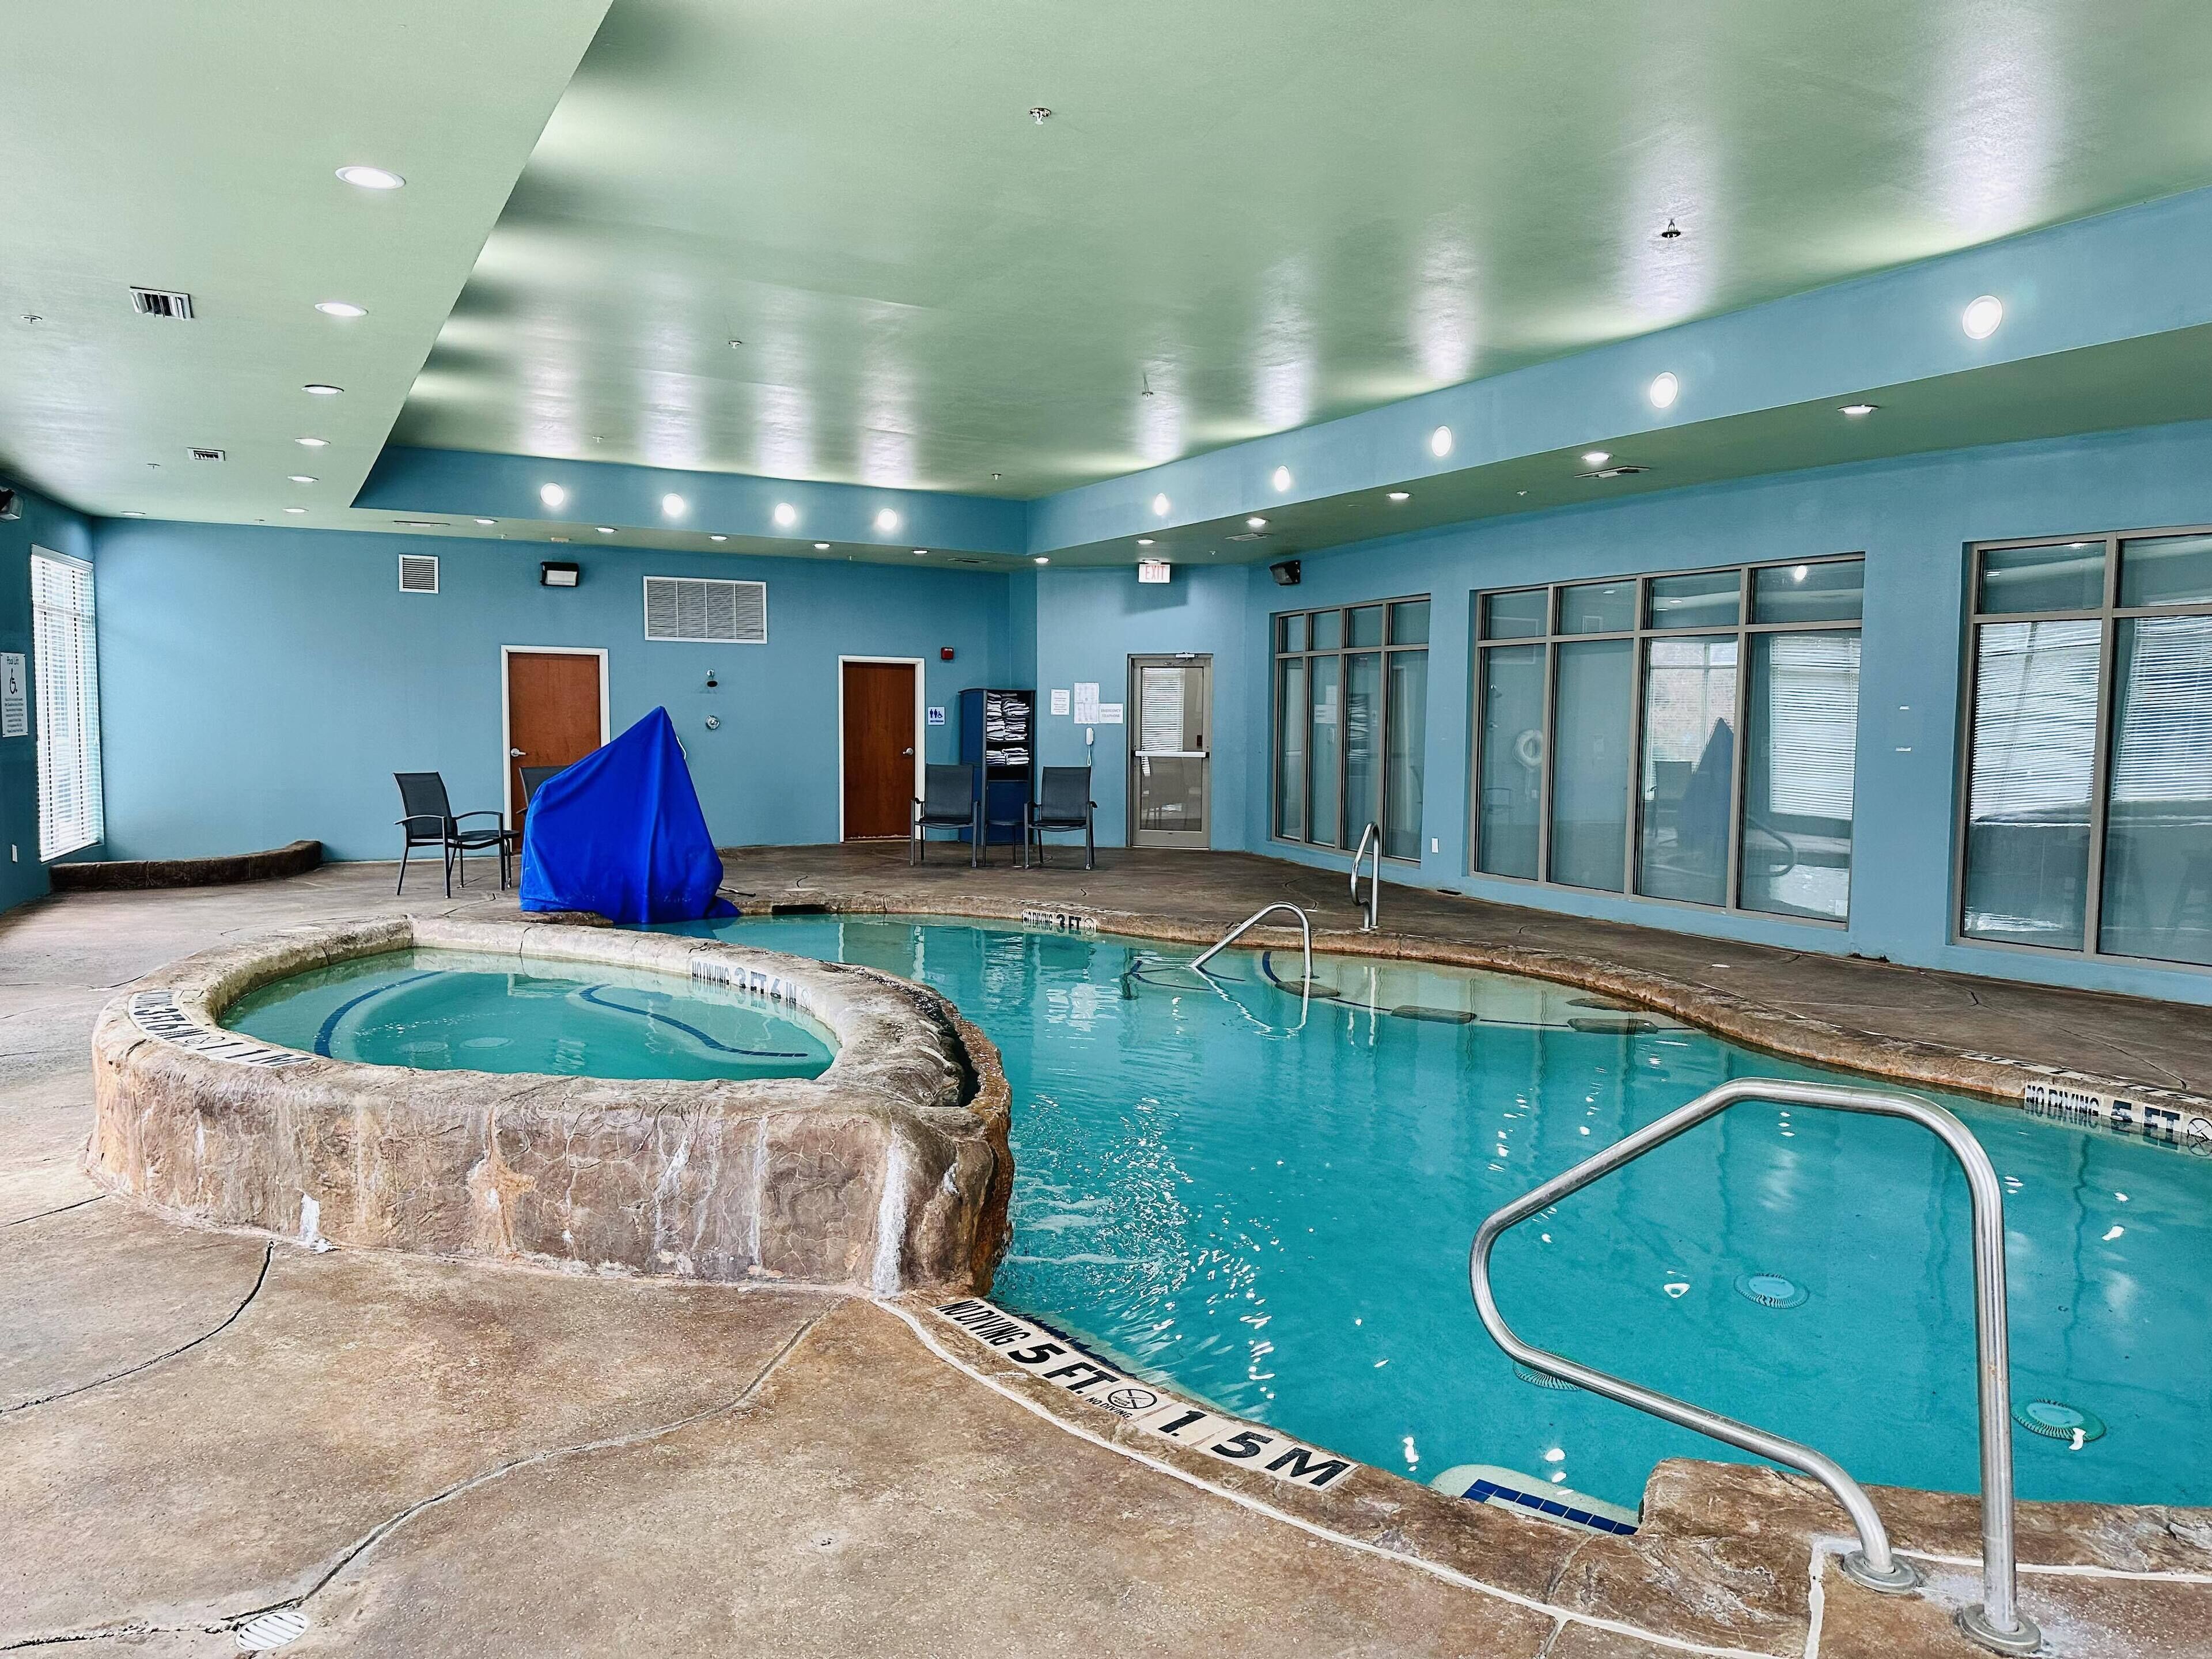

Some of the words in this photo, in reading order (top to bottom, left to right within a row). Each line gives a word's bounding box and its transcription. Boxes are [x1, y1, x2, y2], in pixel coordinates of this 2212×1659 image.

[1145, 565, 1165, 580] EXIT
[1056, 914, 1065, 926] 3
[2027, 1084, 2044, 1104] NO
[2048, 1088, 2100, 1117] DIVING
[935, 1300, 985, 1316] NO
[952, 1309, 1032, 1346] DIVING
[1007, 1343, 1068, 1364] 5
[1085, 1397, 1103, 1405] NO
[1100, 1402, 1133, 1418] DIVING
